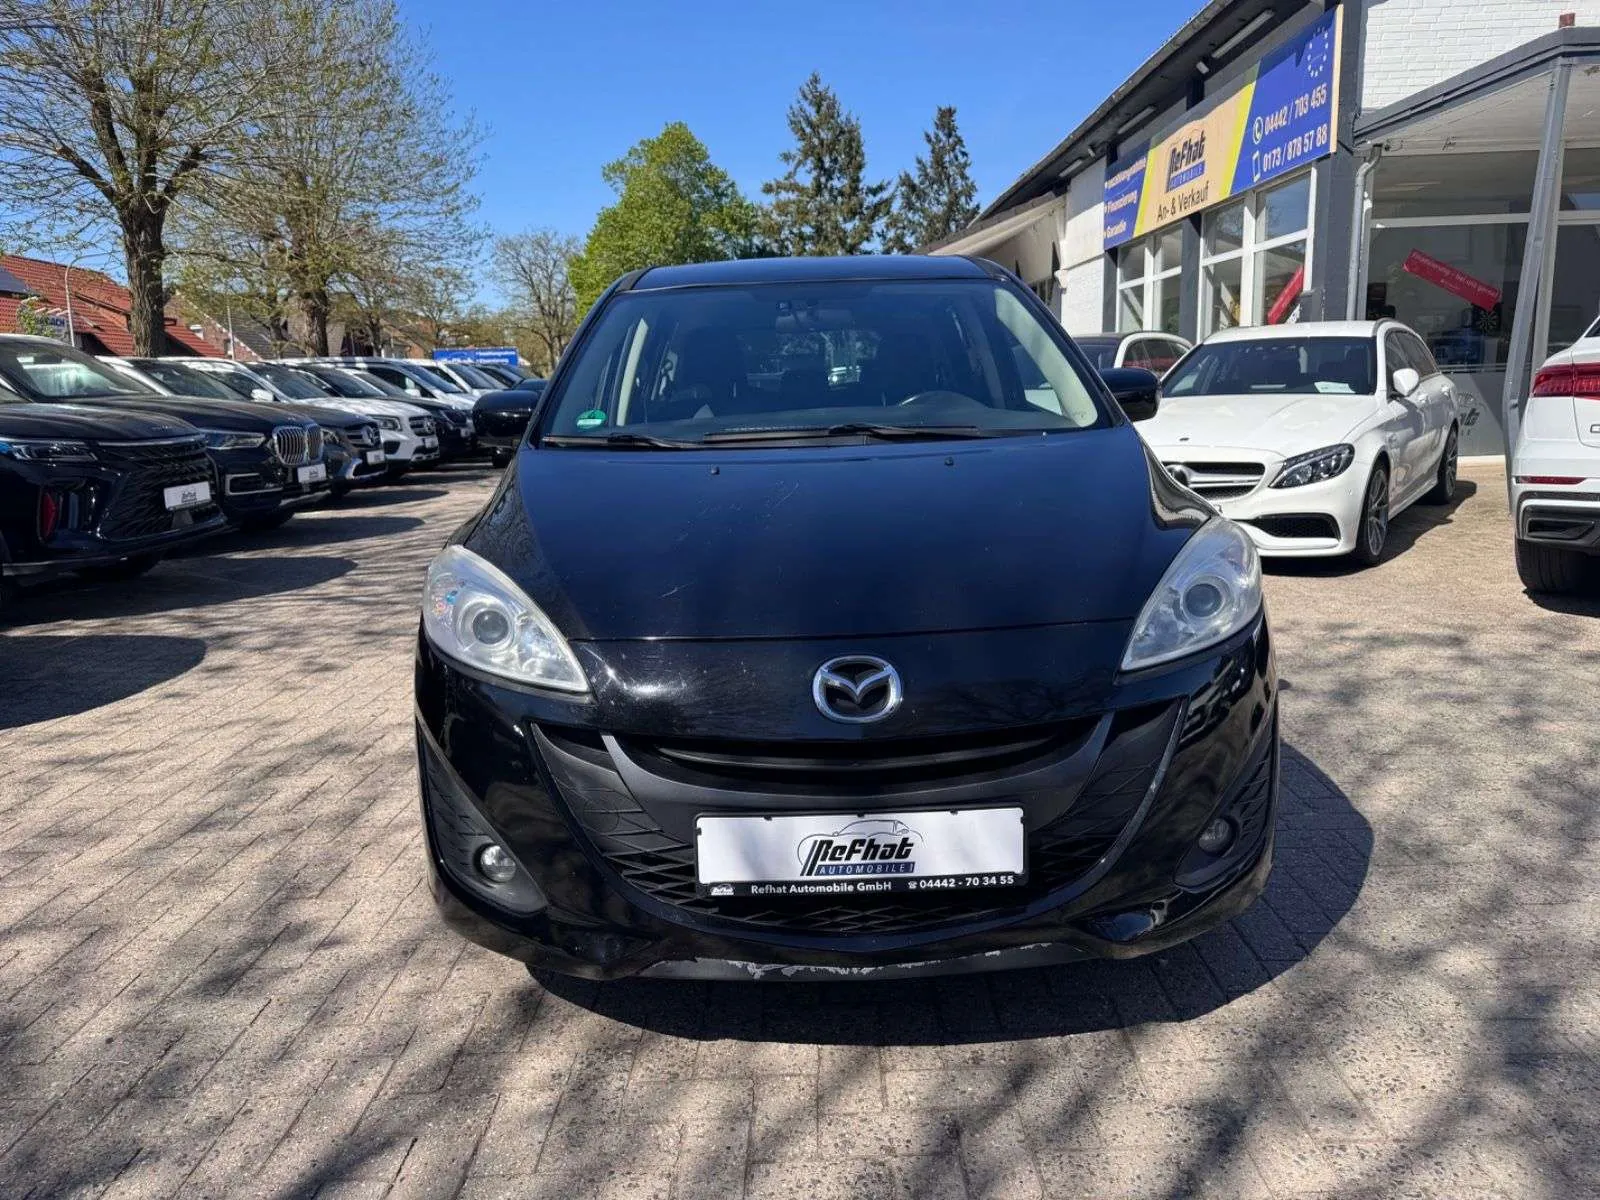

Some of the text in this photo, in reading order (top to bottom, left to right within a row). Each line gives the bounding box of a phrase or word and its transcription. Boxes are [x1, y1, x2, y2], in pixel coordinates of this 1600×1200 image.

[1264, 105, 1288, 136] 04442
[1294, 93, 1309, 119] 703
[1310, 82, 1327, 109] 455
[1263, 147, 1282, 173] 0173
[1303, 129, 1315, 153] 57
[1315, 123, 1328, 148] 88
[1157, 179, 1209, 222] An- & Verkauf
[751, 884, 787, 894] Refhat
[789, 883, 854, 894] Automobile
[857, 881, 892, 892] GmbH
[919, 879, 955, 889] 04442
[965, 877, 980, 886] 70
[982, 876, 997, 885] 34
[1000, 875, 1014, 885] 55
